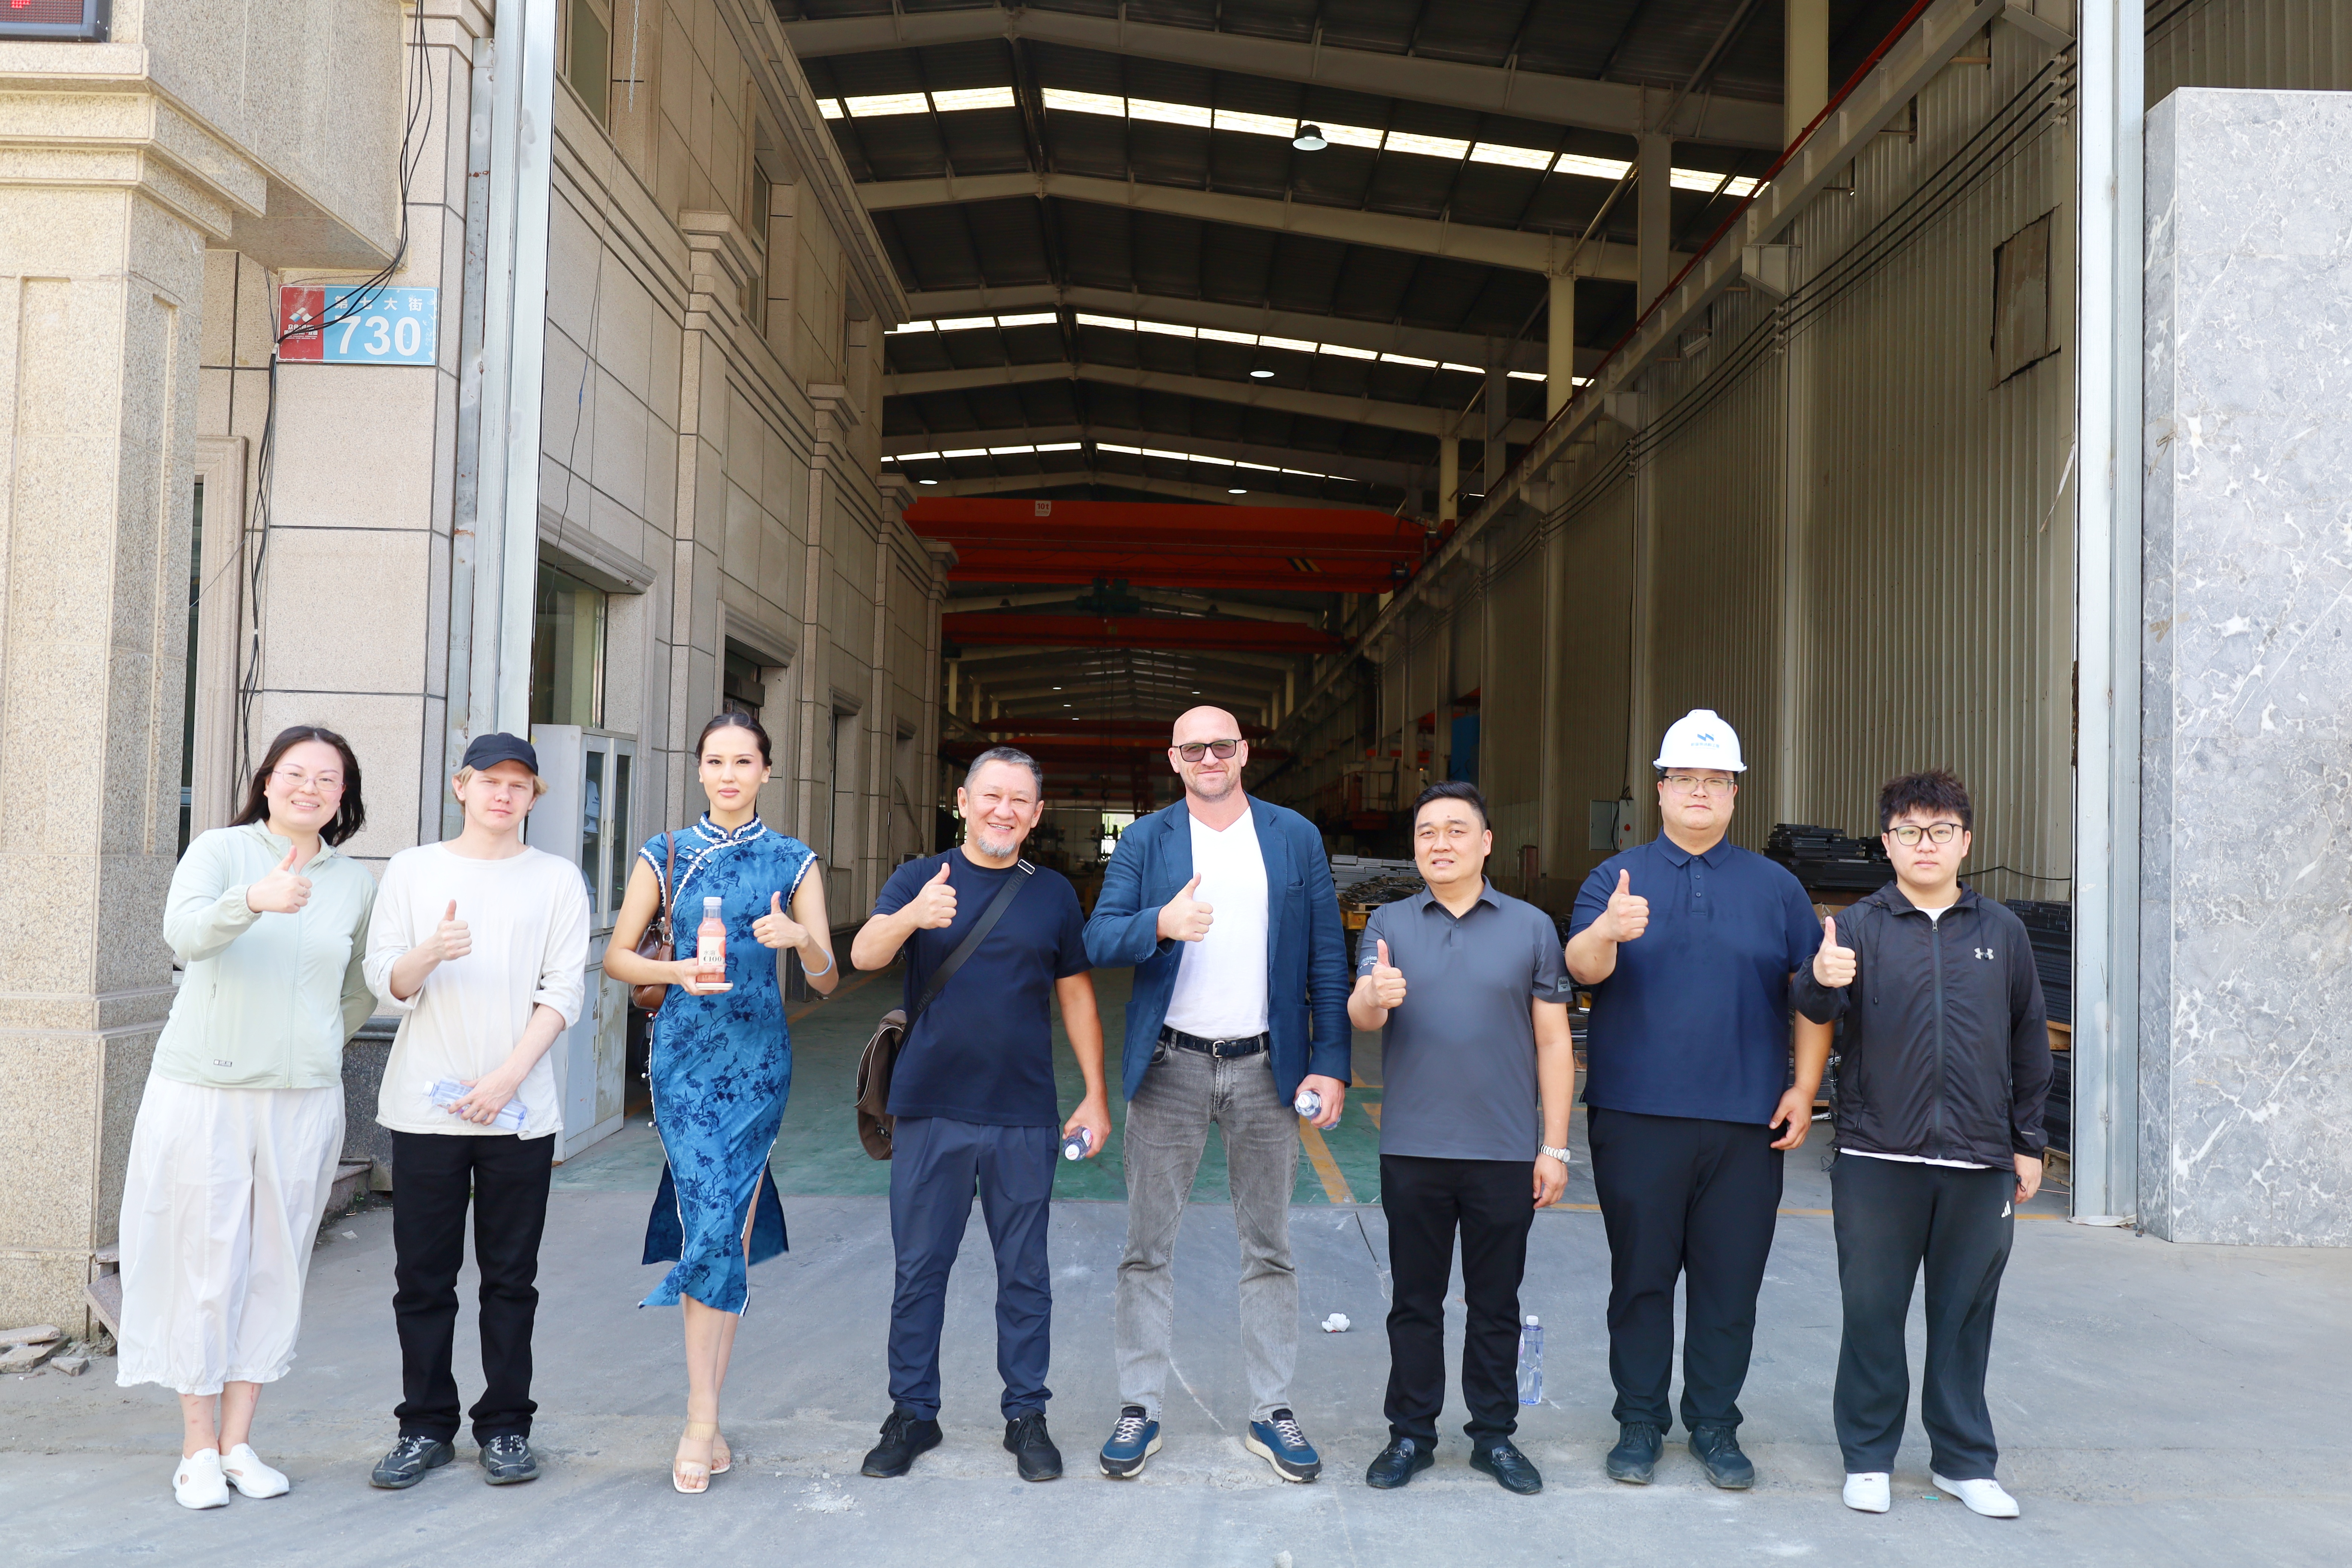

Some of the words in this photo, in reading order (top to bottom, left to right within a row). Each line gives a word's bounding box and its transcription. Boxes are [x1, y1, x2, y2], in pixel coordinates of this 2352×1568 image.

[334, 295, 423, 311] 第七大街
[335, 315, 421, 356] 730
[1009, 870, 1025, 891] POLO
[917, 988, 933, 1011] POLO
